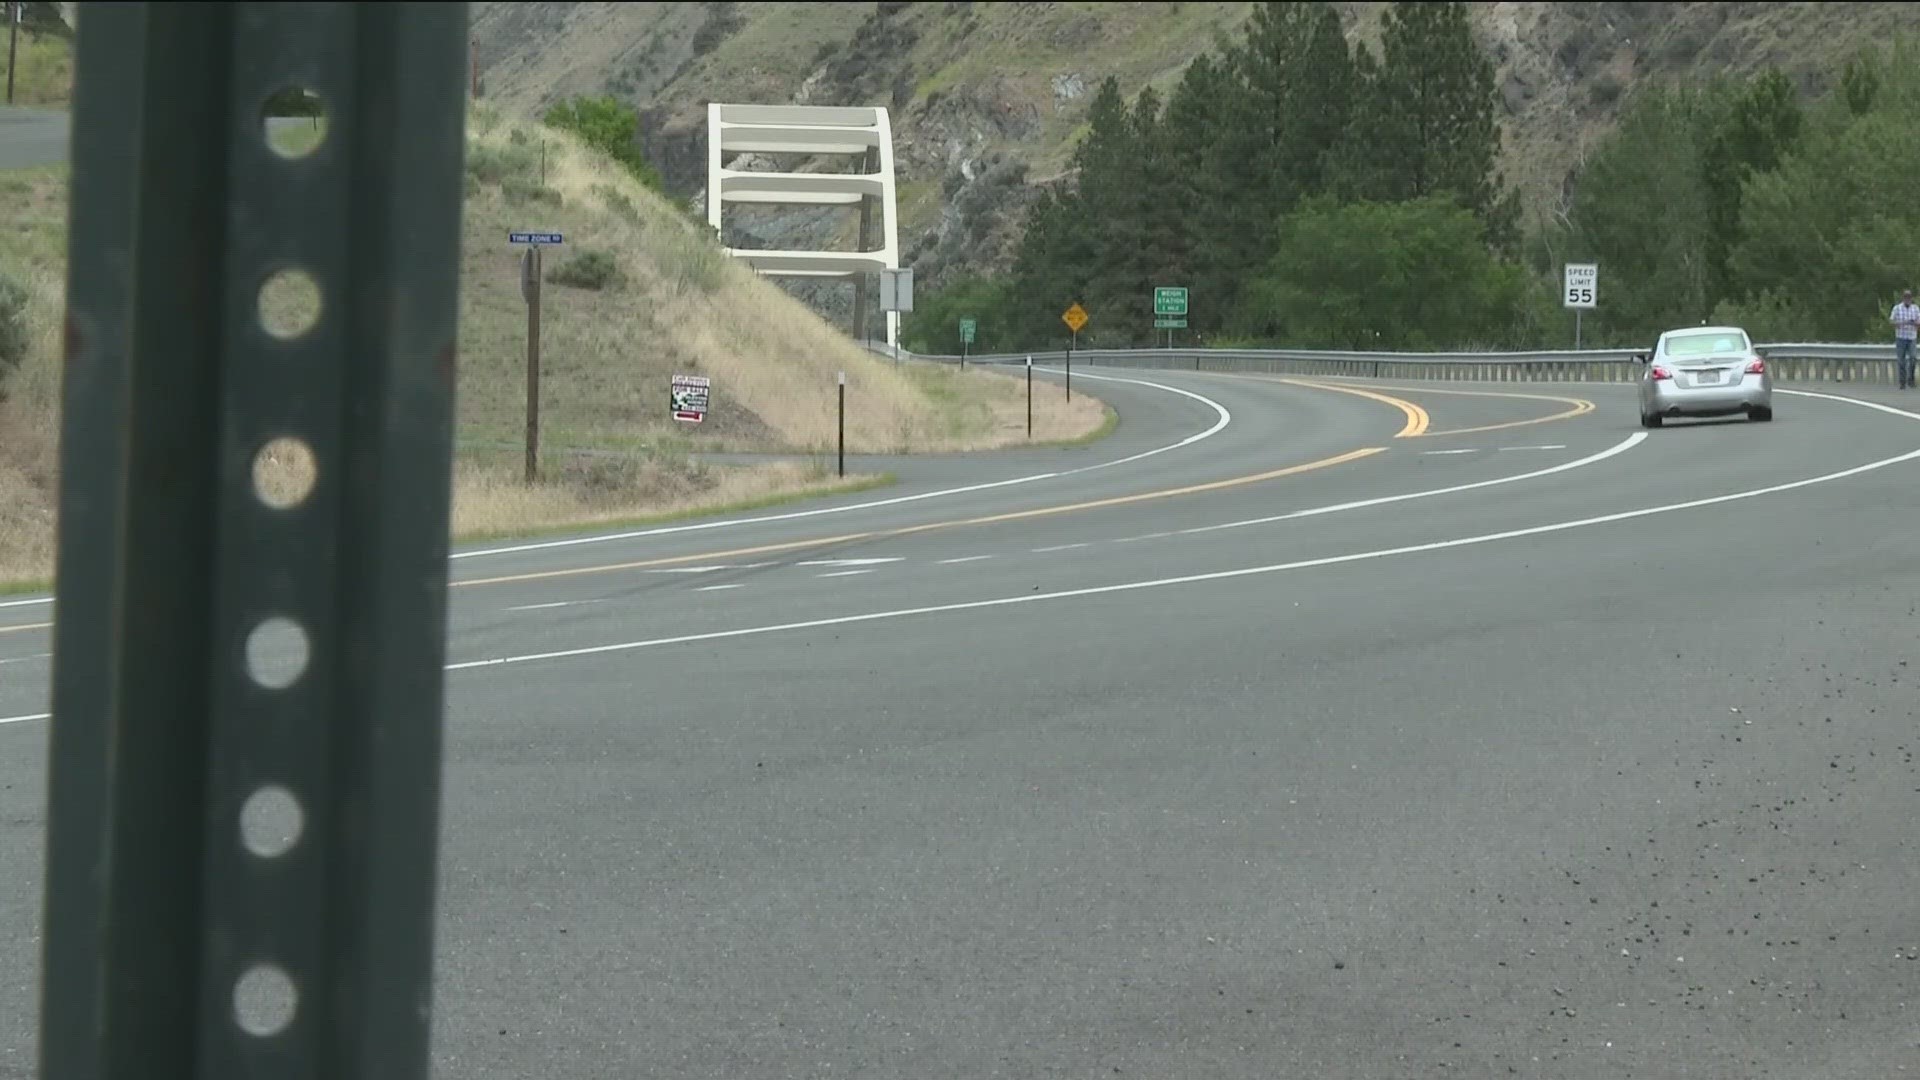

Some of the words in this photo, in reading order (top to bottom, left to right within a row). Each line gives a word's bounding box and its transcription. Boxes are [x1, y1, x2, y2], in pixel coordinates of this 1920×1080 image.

[511, 234, 530, 243] TIME
[531, 234, 551, 243] ZONE
[1568, 268, 1595, 276] SPEED
[1570, 278, 1591, 286] LIMIT
[1569, 288, 1592, 303] 55
[674, 385, 688, 393] FOR
